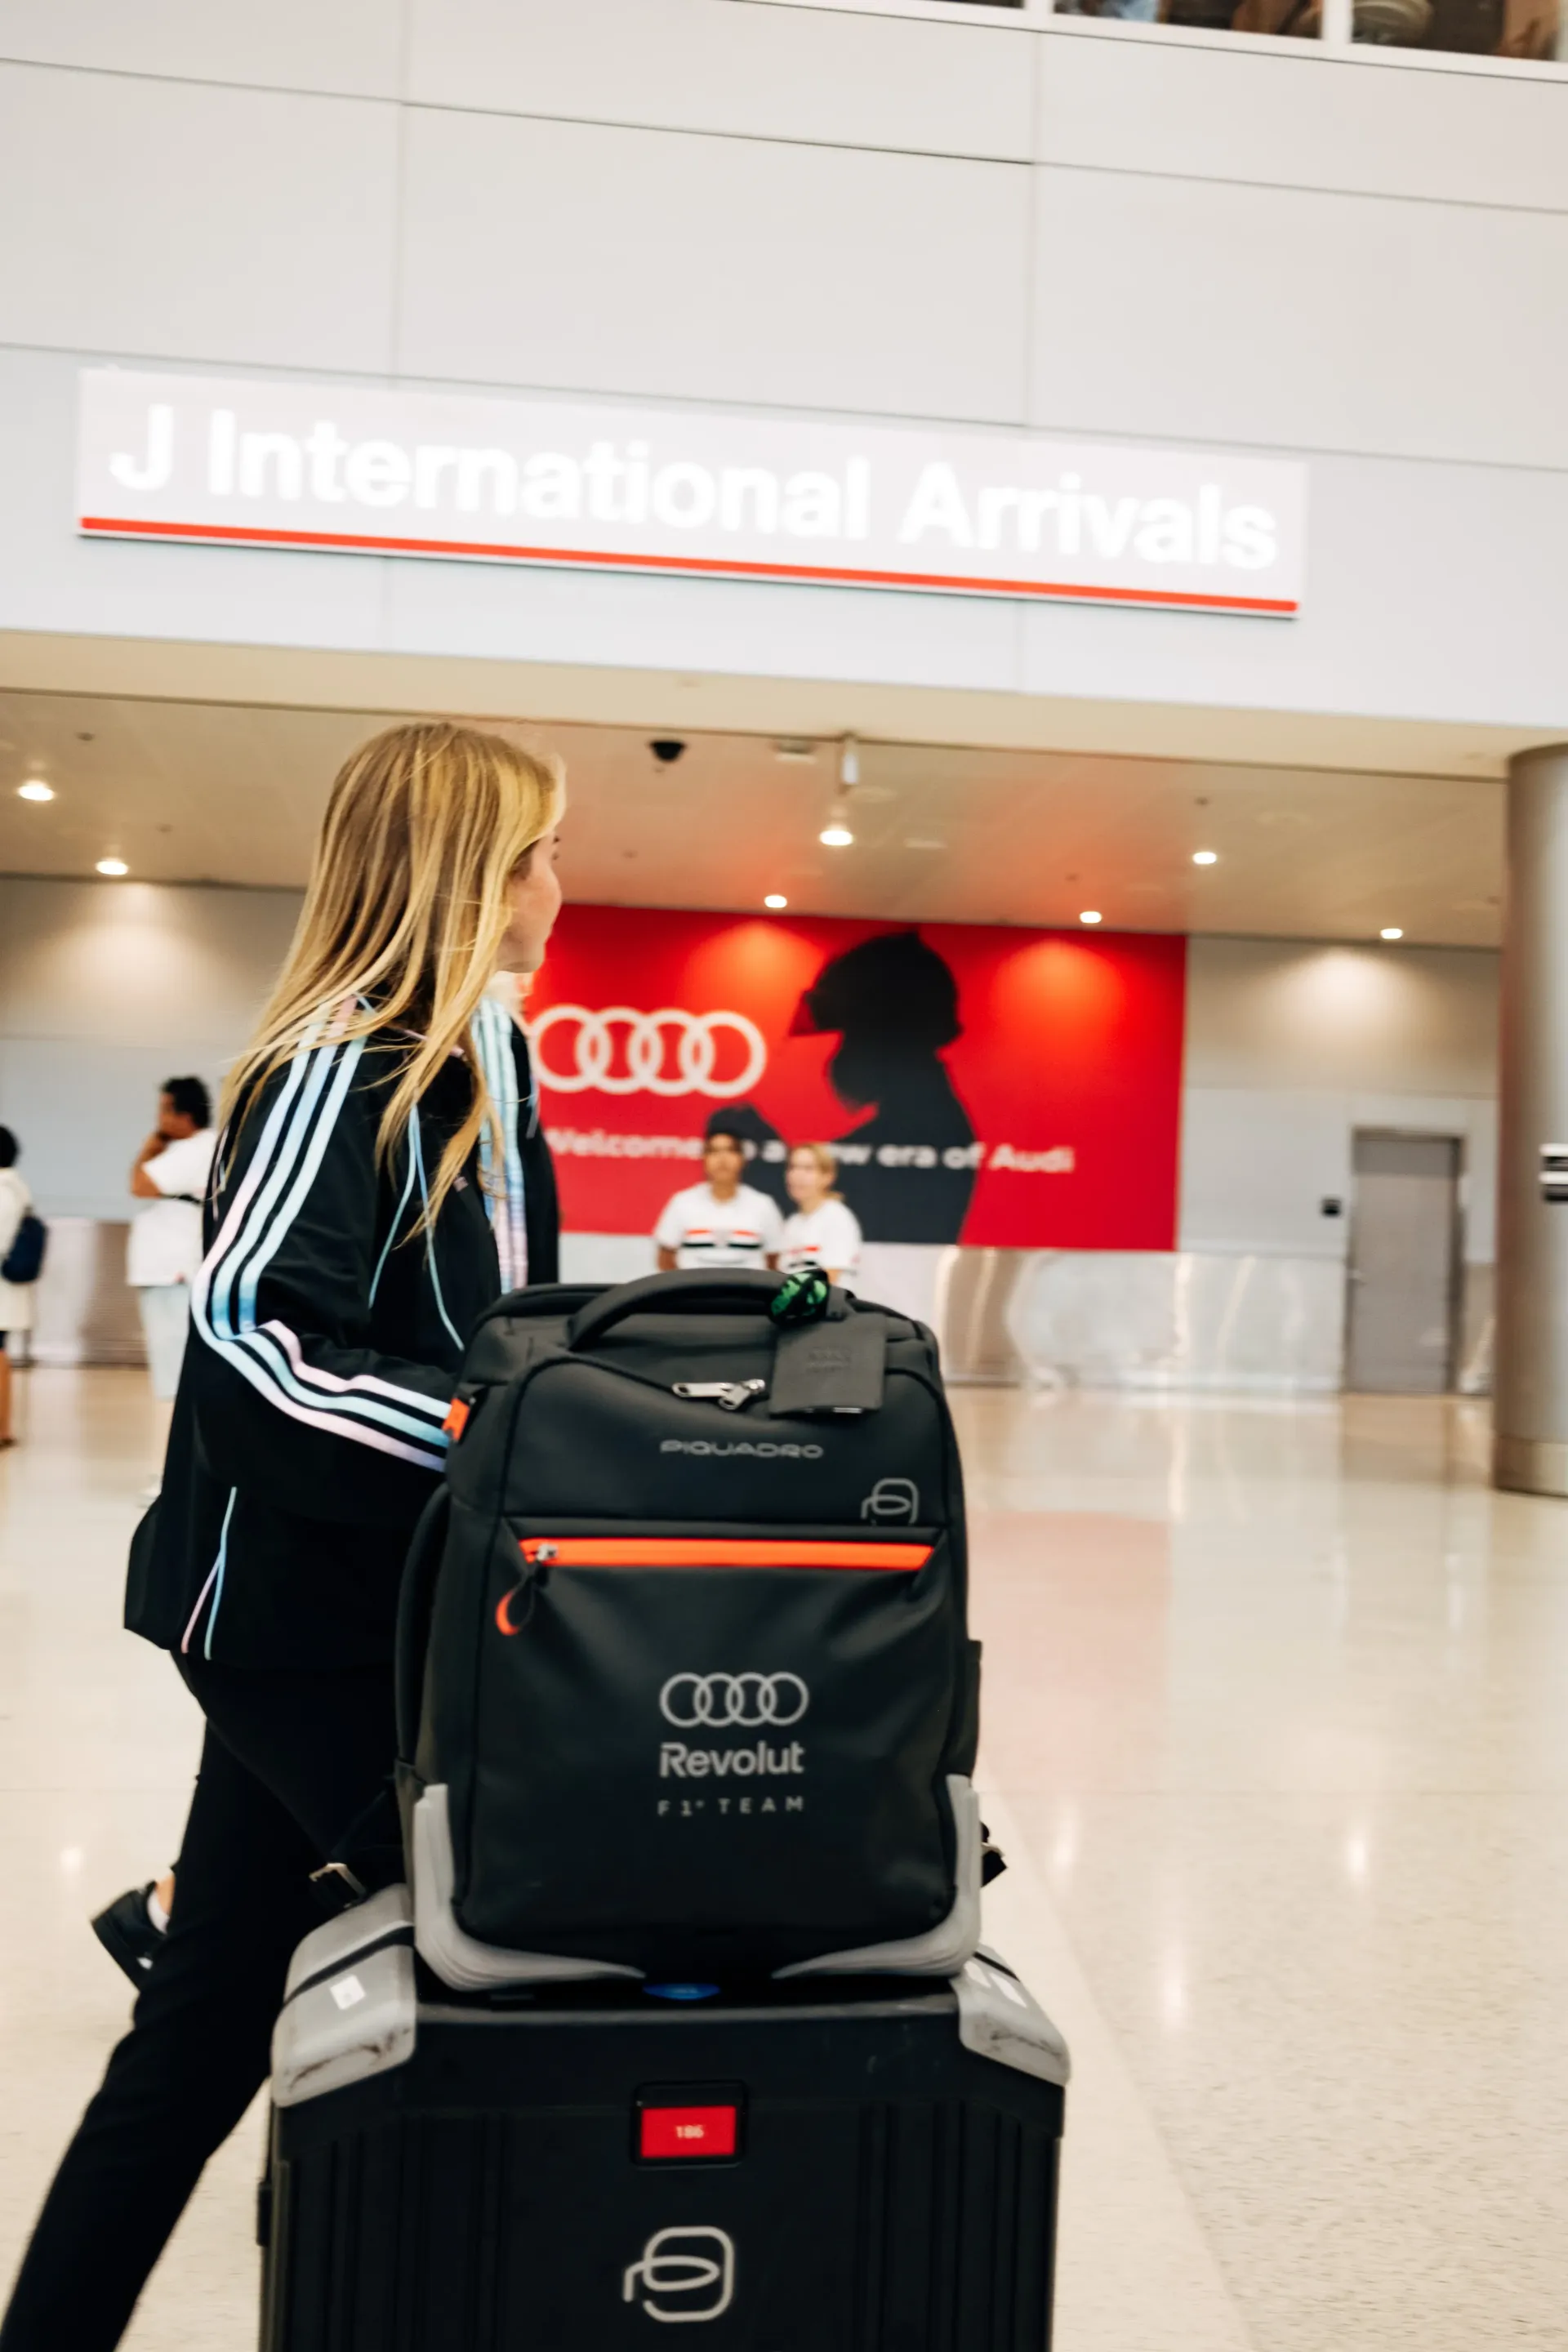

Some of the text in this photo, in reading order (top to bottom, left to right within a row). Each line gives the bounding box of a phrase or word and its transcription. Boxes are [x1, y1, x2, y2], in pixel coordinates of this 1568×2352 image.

[108, 403, 1278, 571] J International Arrivals
[742, 1138, 758, 1161] o
[761, 1140, 787, 1163] a
[876, 1143, 938, 1169] era
[942, 1141, 985, 1170] of
[989, 1143, 1076, 1174] Audi
[660, 1439, 824, 1459] PIQUADRO
[659, 1740, 804, 1778] Revolut
[718, 1796, 804, 1815] TEAM
